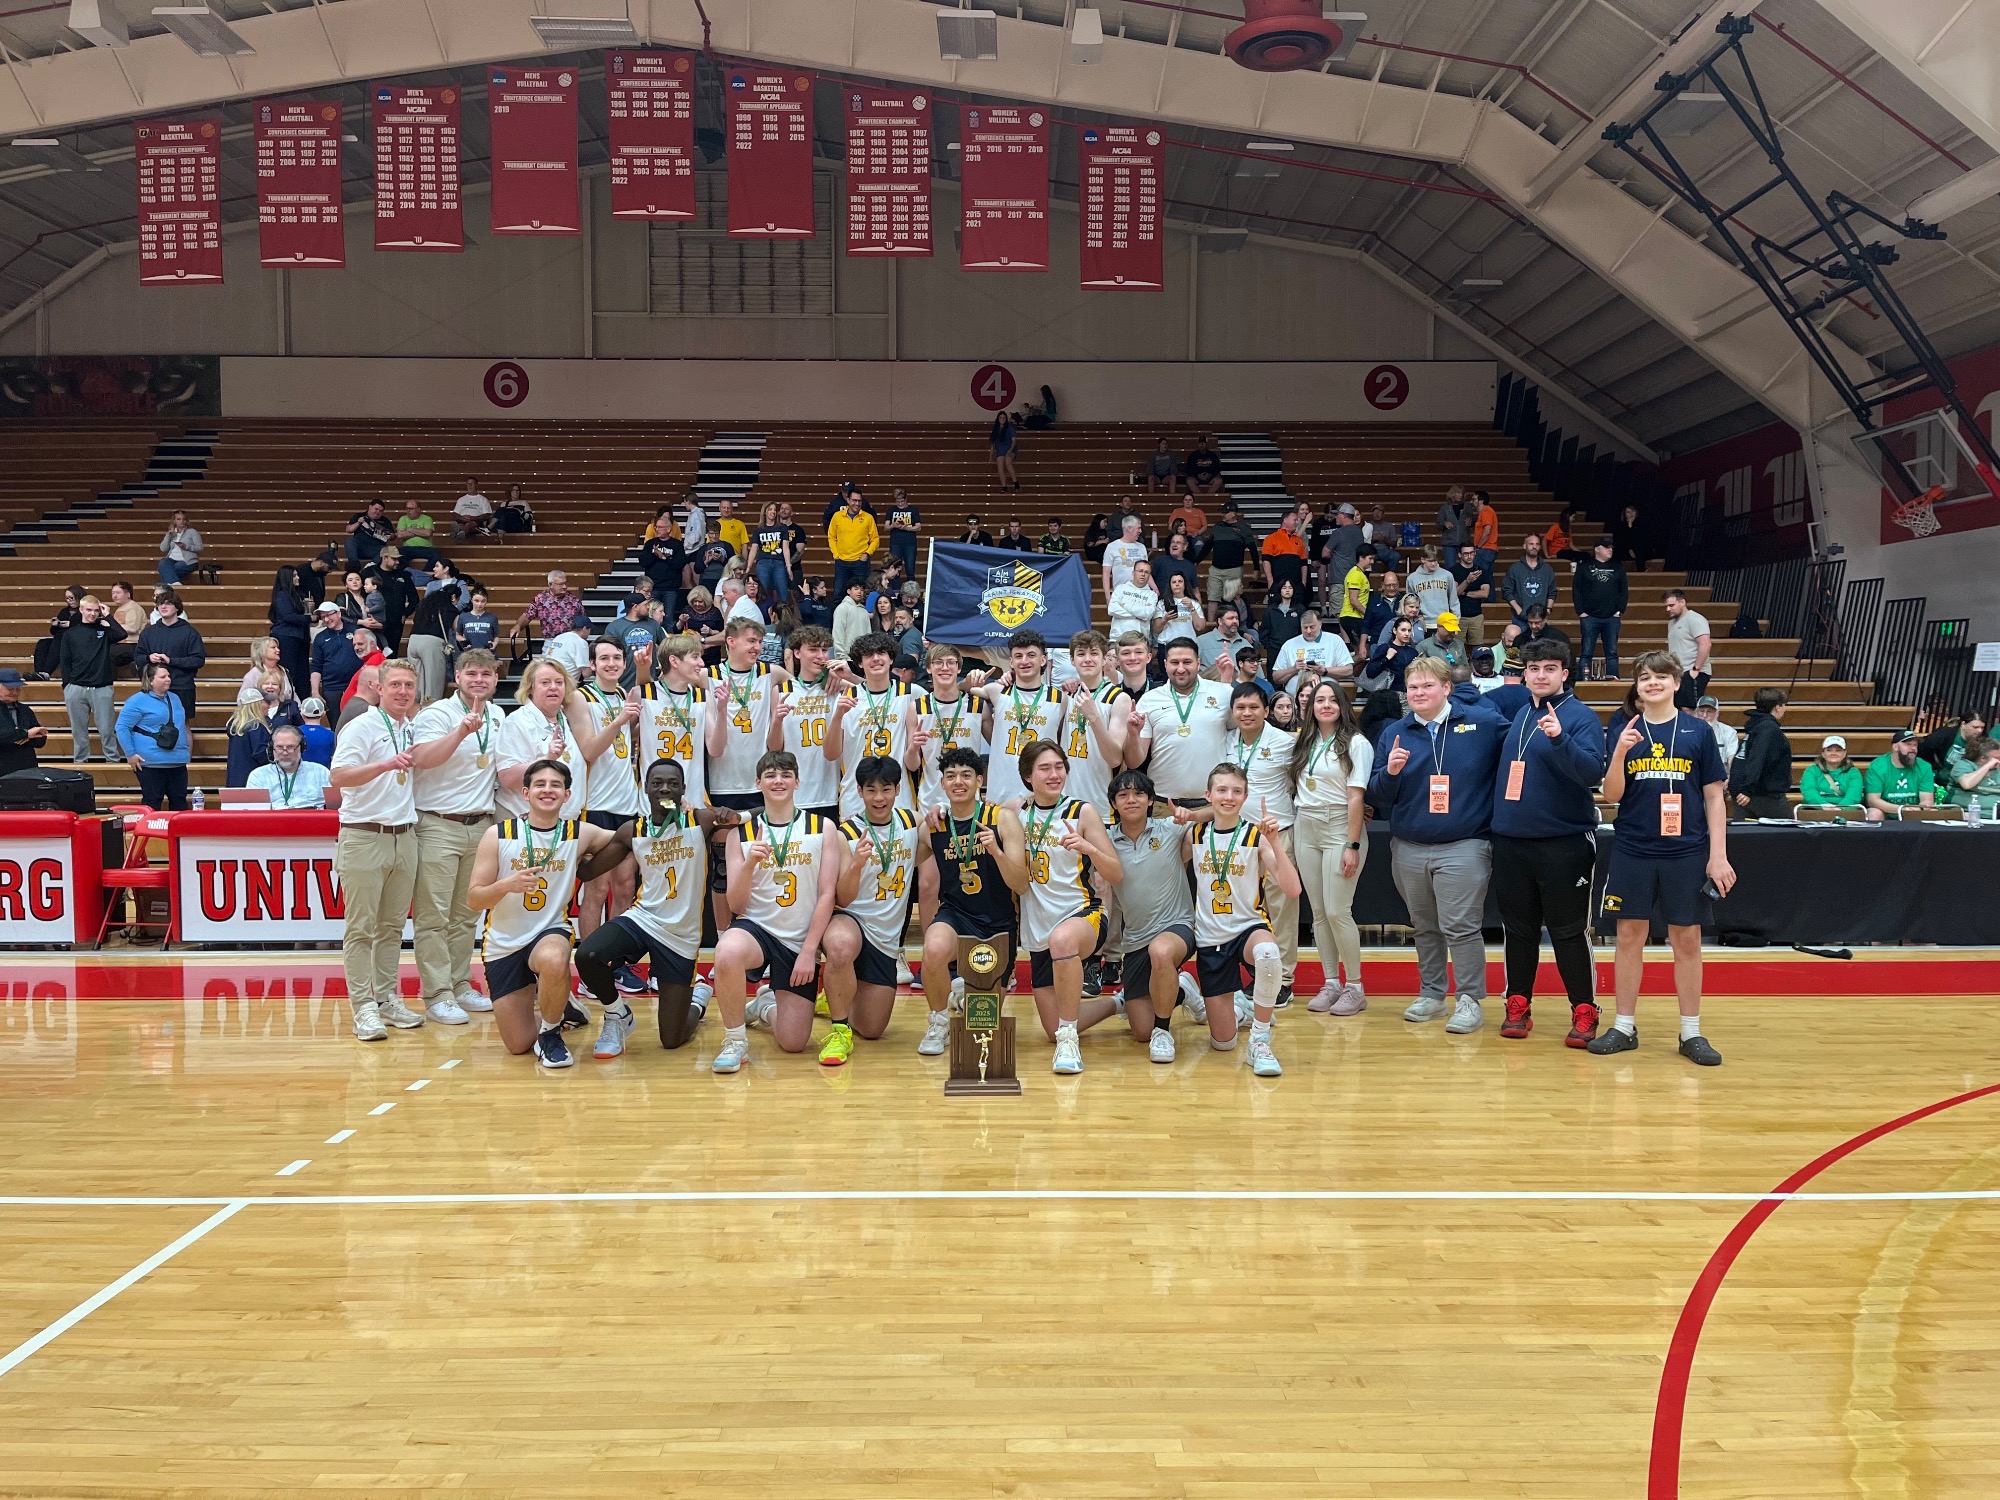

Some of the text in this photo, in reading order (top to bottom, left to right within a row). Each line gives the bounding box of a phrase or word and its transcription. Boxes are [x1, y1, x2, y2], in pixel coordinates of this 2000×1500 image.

[378, 201, 393, 210] 2012
[1088, 222, 1102, 231] 2013
[494, 369, 519, 400] 6
[980, 371, 1007, 404] 4
[1375, 372, 1398, 404] 2
[760, 532, 781, 542] CLEVE
[987, 588, 1040, 601] SAINT IGNATIUS
[1415, 580, 1448, 592] IGNATIUS
[733, 706, 752, 733] 4
[800, 718, 827, 748] 10
[657, 731, 693, 760] 34
[863, 728, 892, 757] 19
[665, 867, 678, 900] 1
[776, 872, 797, 907] 3
[875, 866, 905, 901] 14
[959, 861, 982, 895] 5
[523, 877, 547, 911] 6
[1211, 879, 1233, 914] 2
[973, 954, 993, 963] OHSAA
